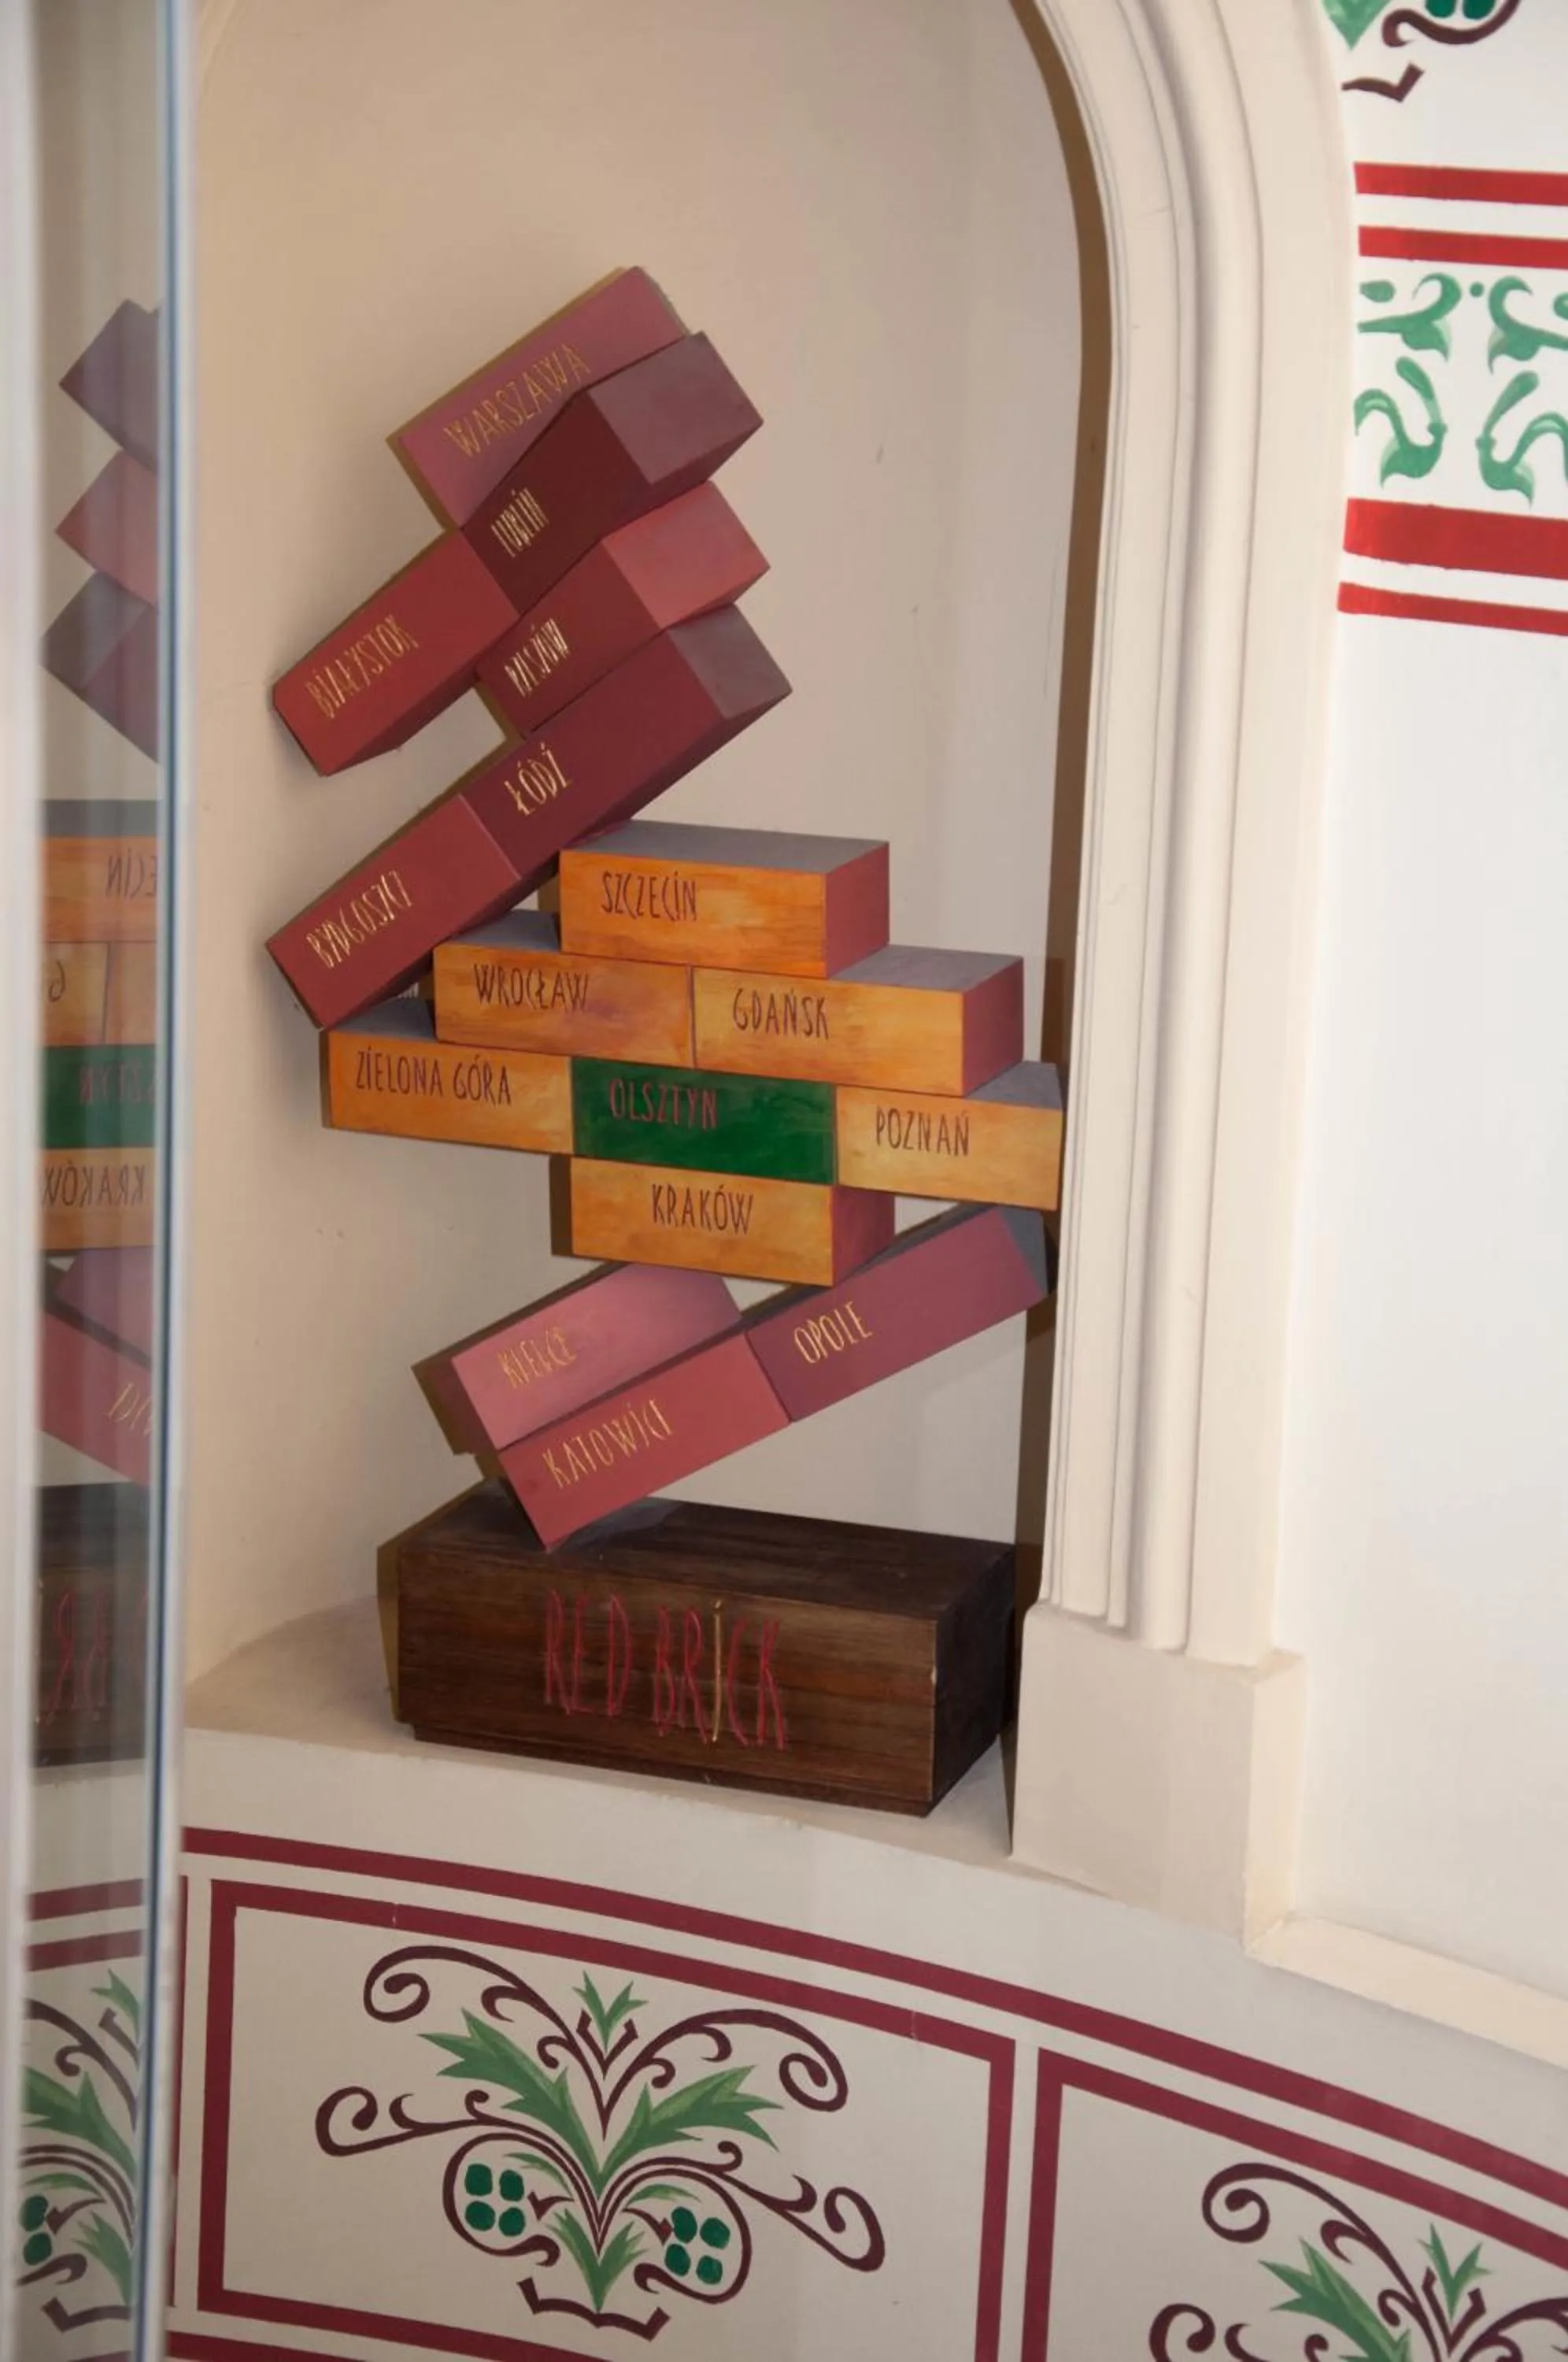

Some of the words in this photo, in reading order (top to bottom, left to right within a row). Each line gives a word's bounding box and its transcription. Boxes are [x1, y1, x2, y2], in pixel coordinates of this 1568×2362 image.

[442, 343, 590, 457] WARSZAWA
[601, 869, 697, 922] SZCZECIN
[473, 962, 589, 1012] WROCŁAW
[733, 987, 829, 1040] GDAŃSK
[356, 1046, 443, 1099] ZIELONA
[453, 1053, 511, 1109] GÓRA
[608, 1077, 718, 1132] OLSZTYN
[875, 1104, 970, 1157] POZNAŃ
[652, 1183, 754, 1236] KRAKÓW
[793, 1300, 874, 1364] OPOLE
[544, 1588, 632, 1718] RED
[652, 1598, 786, 1751] BRICK
